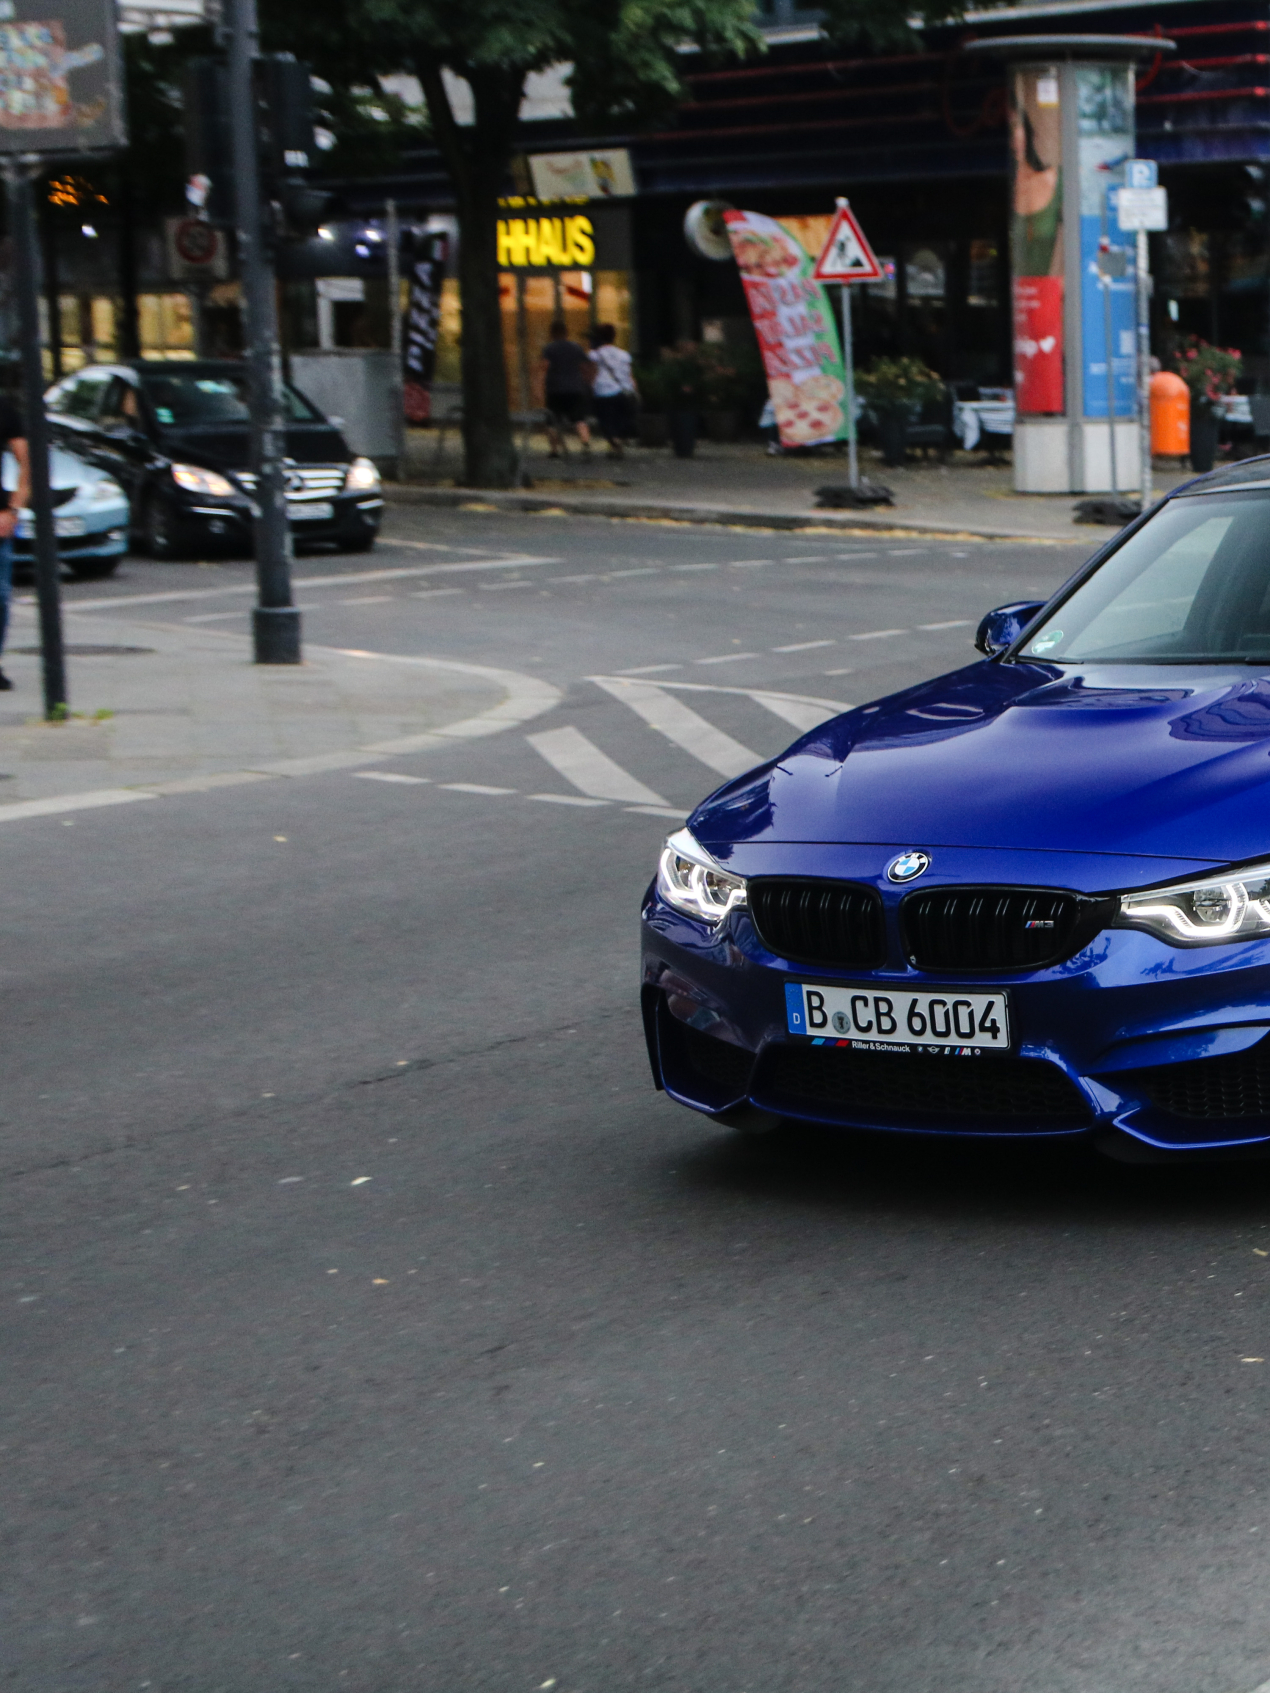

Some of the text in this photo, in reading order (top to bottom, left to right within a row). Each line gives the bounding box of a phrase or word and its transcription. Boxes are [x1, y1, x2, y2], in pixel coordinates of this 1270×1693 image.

[806, 990, 1000, 1040] B CB 6004
